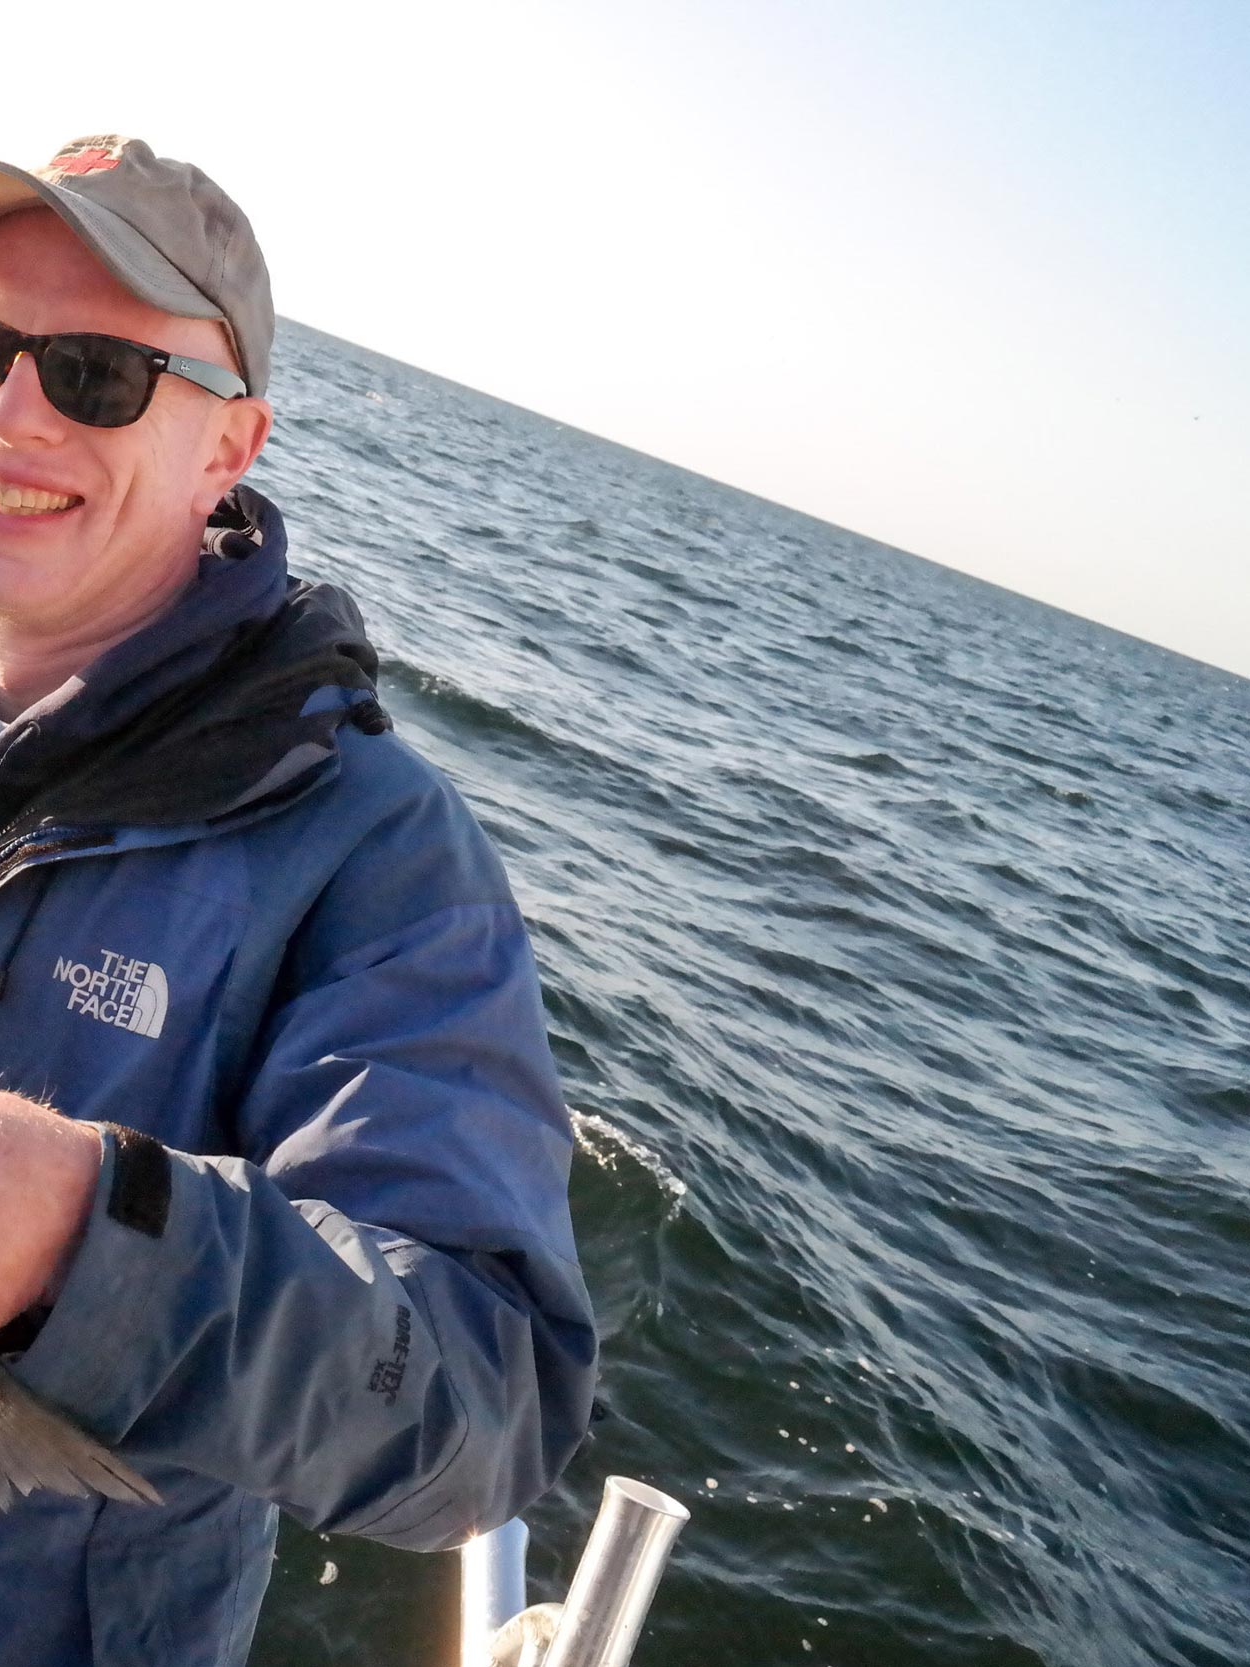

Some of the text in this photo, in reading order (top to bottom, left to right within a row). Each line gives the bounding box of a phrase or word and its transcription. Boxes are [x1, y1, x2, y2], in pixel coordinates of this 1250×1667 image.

[52, 956, 141, 1007] NORTH
[101, 949, 149, 983] THE
[67, 988, 134, 1028] FACE
